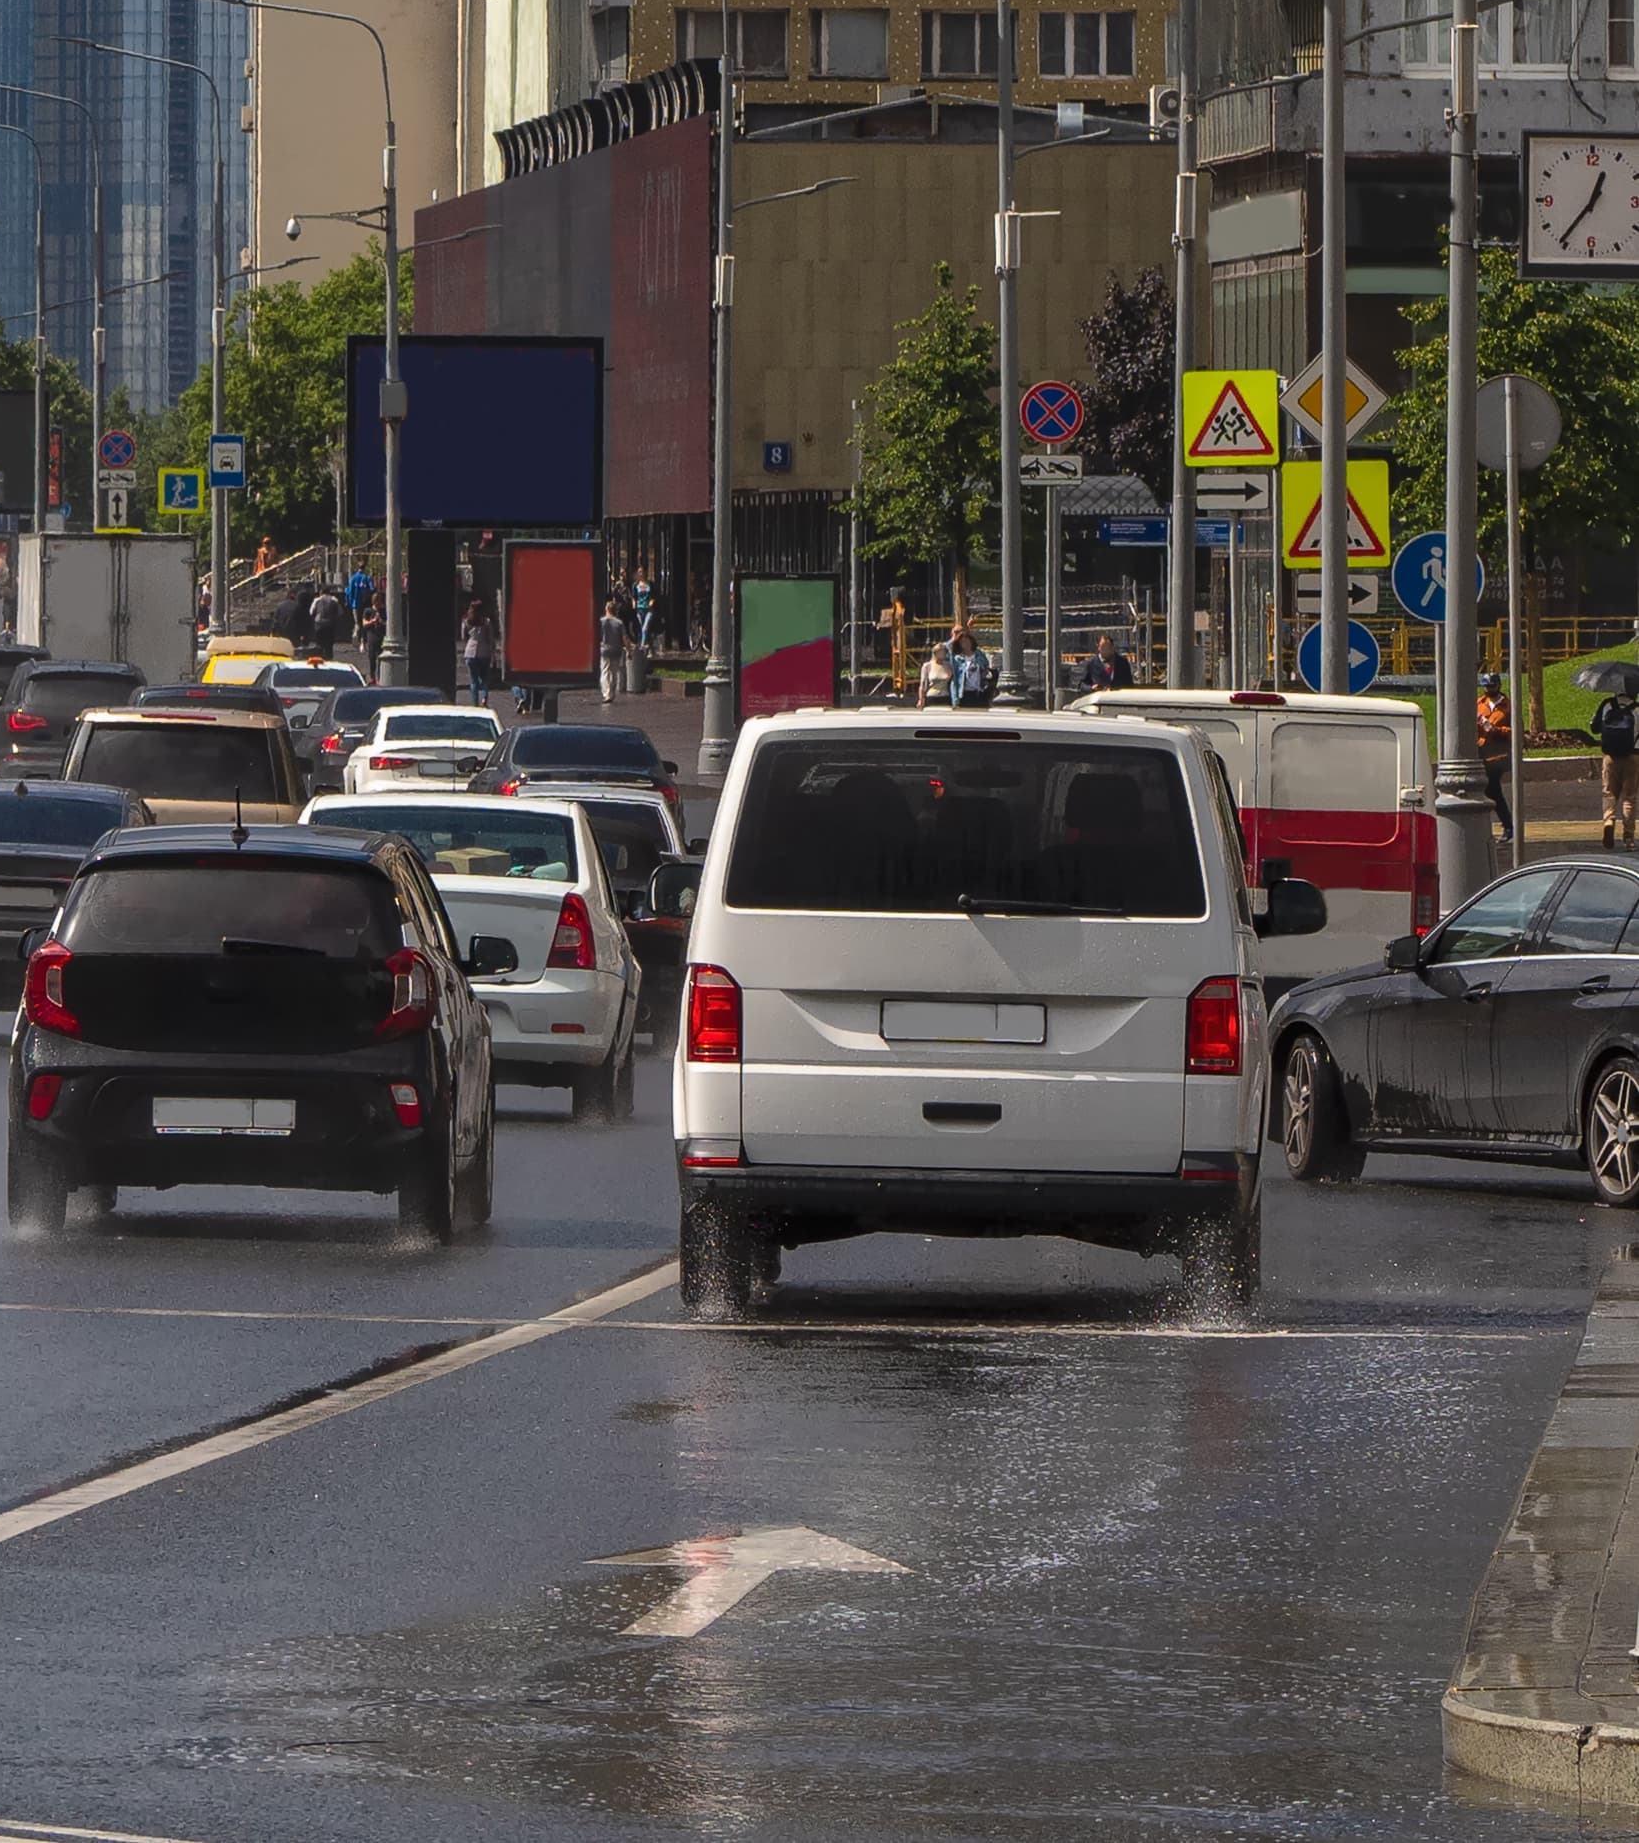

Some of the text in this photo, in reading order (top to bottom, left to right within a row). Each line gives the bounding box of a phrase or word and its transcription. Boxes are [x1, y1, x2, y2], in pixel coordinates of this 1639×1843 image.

[1586, 154, 1600, 166] 12
[1543, 195, 1554, 207] 9
[1630, 196, 1639, 209] 3
[1586, 236, 1596, 248] 6
[771, 446, 782, 464] 8
